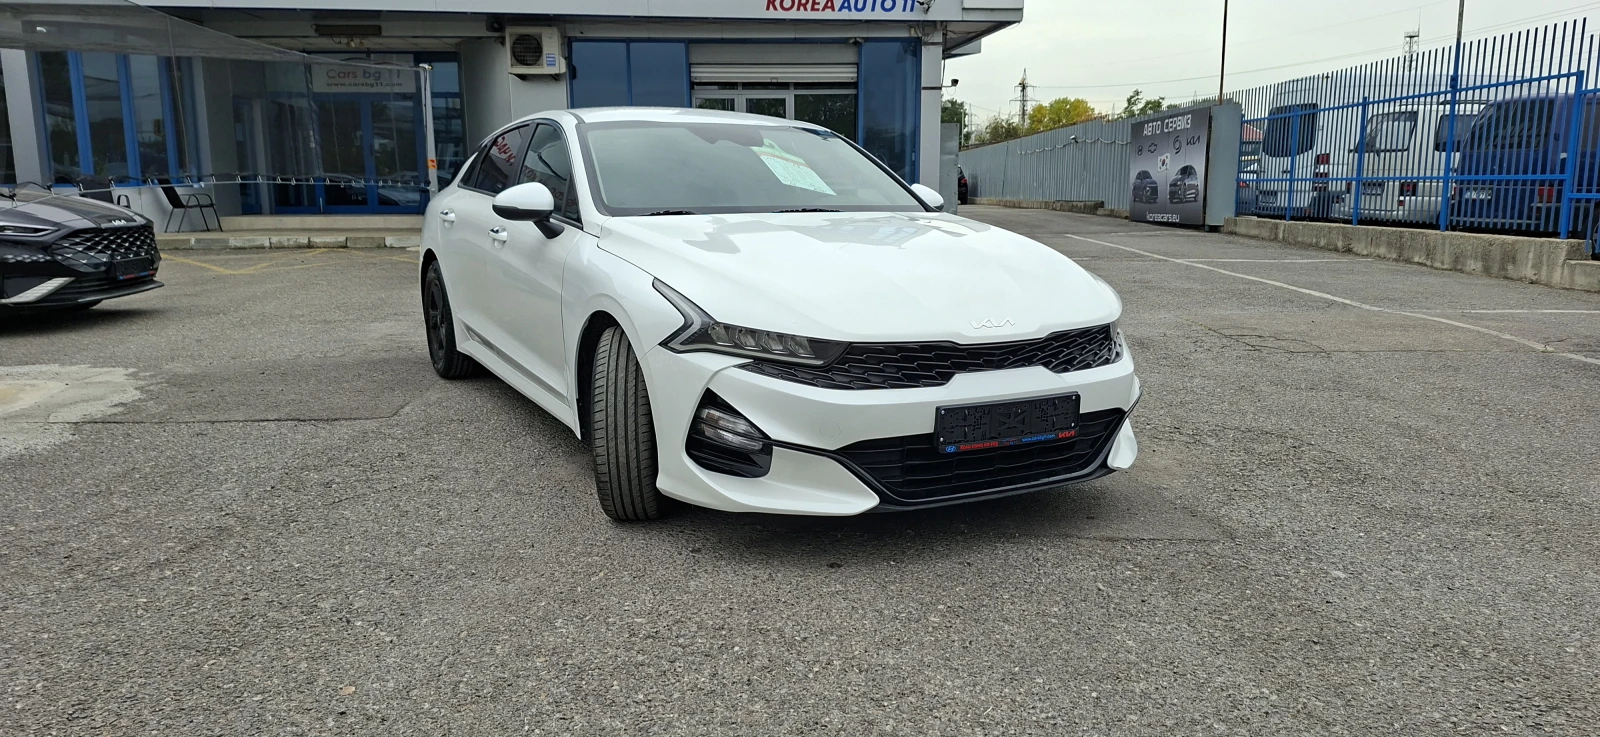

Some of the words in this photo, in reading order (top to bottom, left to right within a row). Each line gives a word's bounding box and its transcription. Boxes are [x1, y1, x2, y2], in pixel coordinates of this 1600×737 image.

[766, 0, 836, 12] KOREA
[837, 0, 897, 12] AUTO
[325, 68, 358, 79] Cars
[362, 69, 381, 81] bg
[1143, 121, 1161, 136] АВТО
[1163, 114, 1192, 132] СЕРВИЗ
[1146, 211, 1180, 222] koreacars.eu
